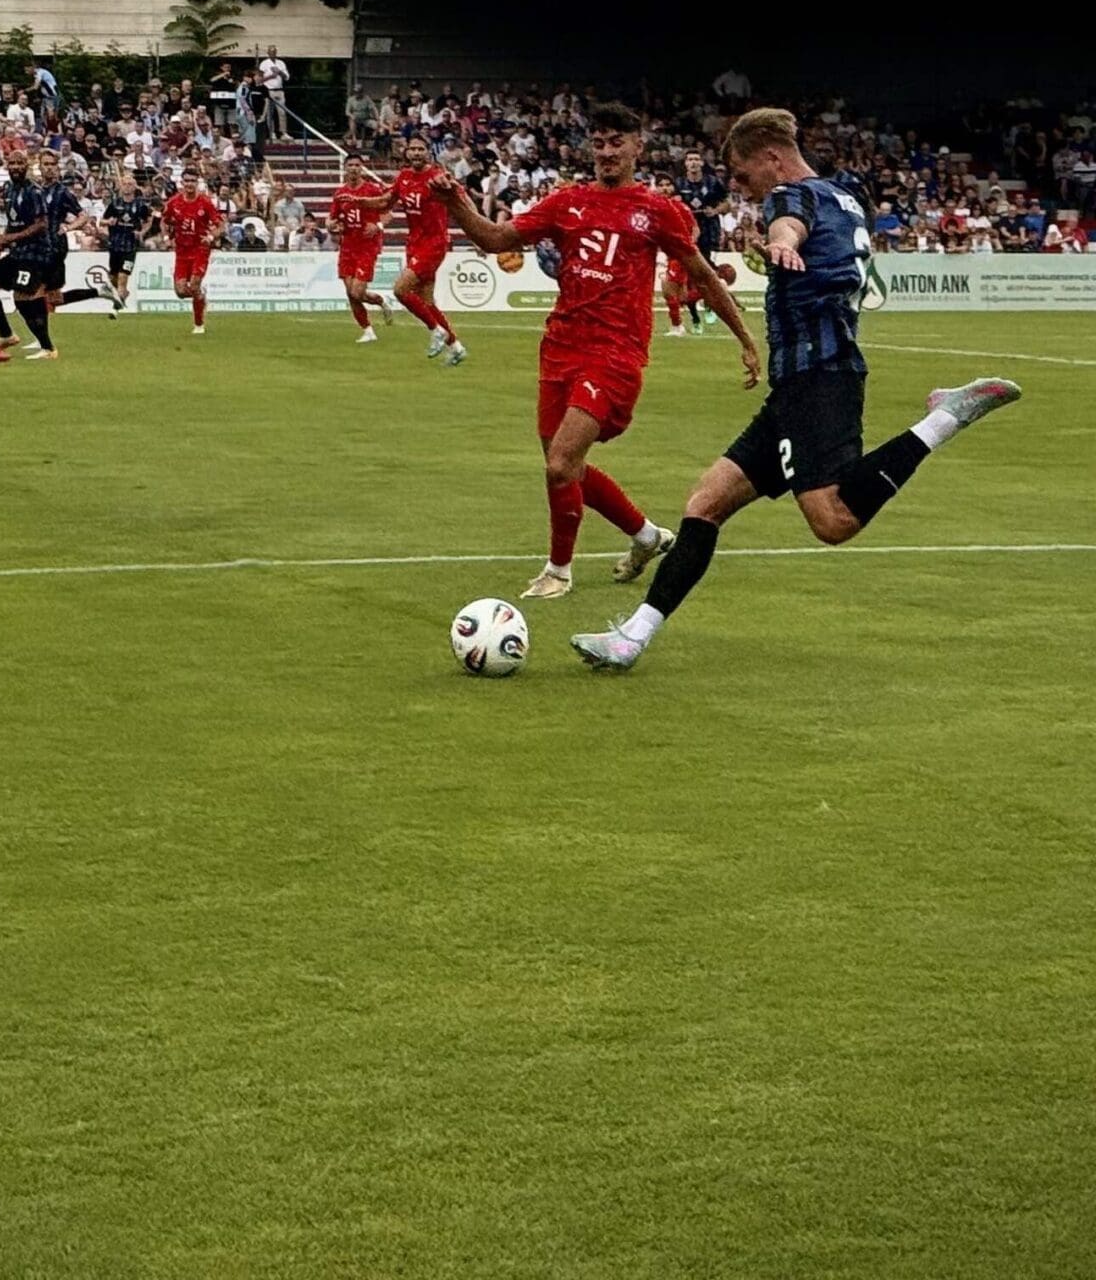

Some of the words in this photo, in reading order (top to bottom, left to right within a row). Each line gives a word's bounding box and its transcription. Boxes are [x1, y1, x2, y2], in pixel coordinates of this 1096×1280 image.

[16, 270, 31, 285] 13
[890, 274, 937, 293] ANTON
[941, 274, 971, 293] ANK
[778, 438, 795, 480] 2
